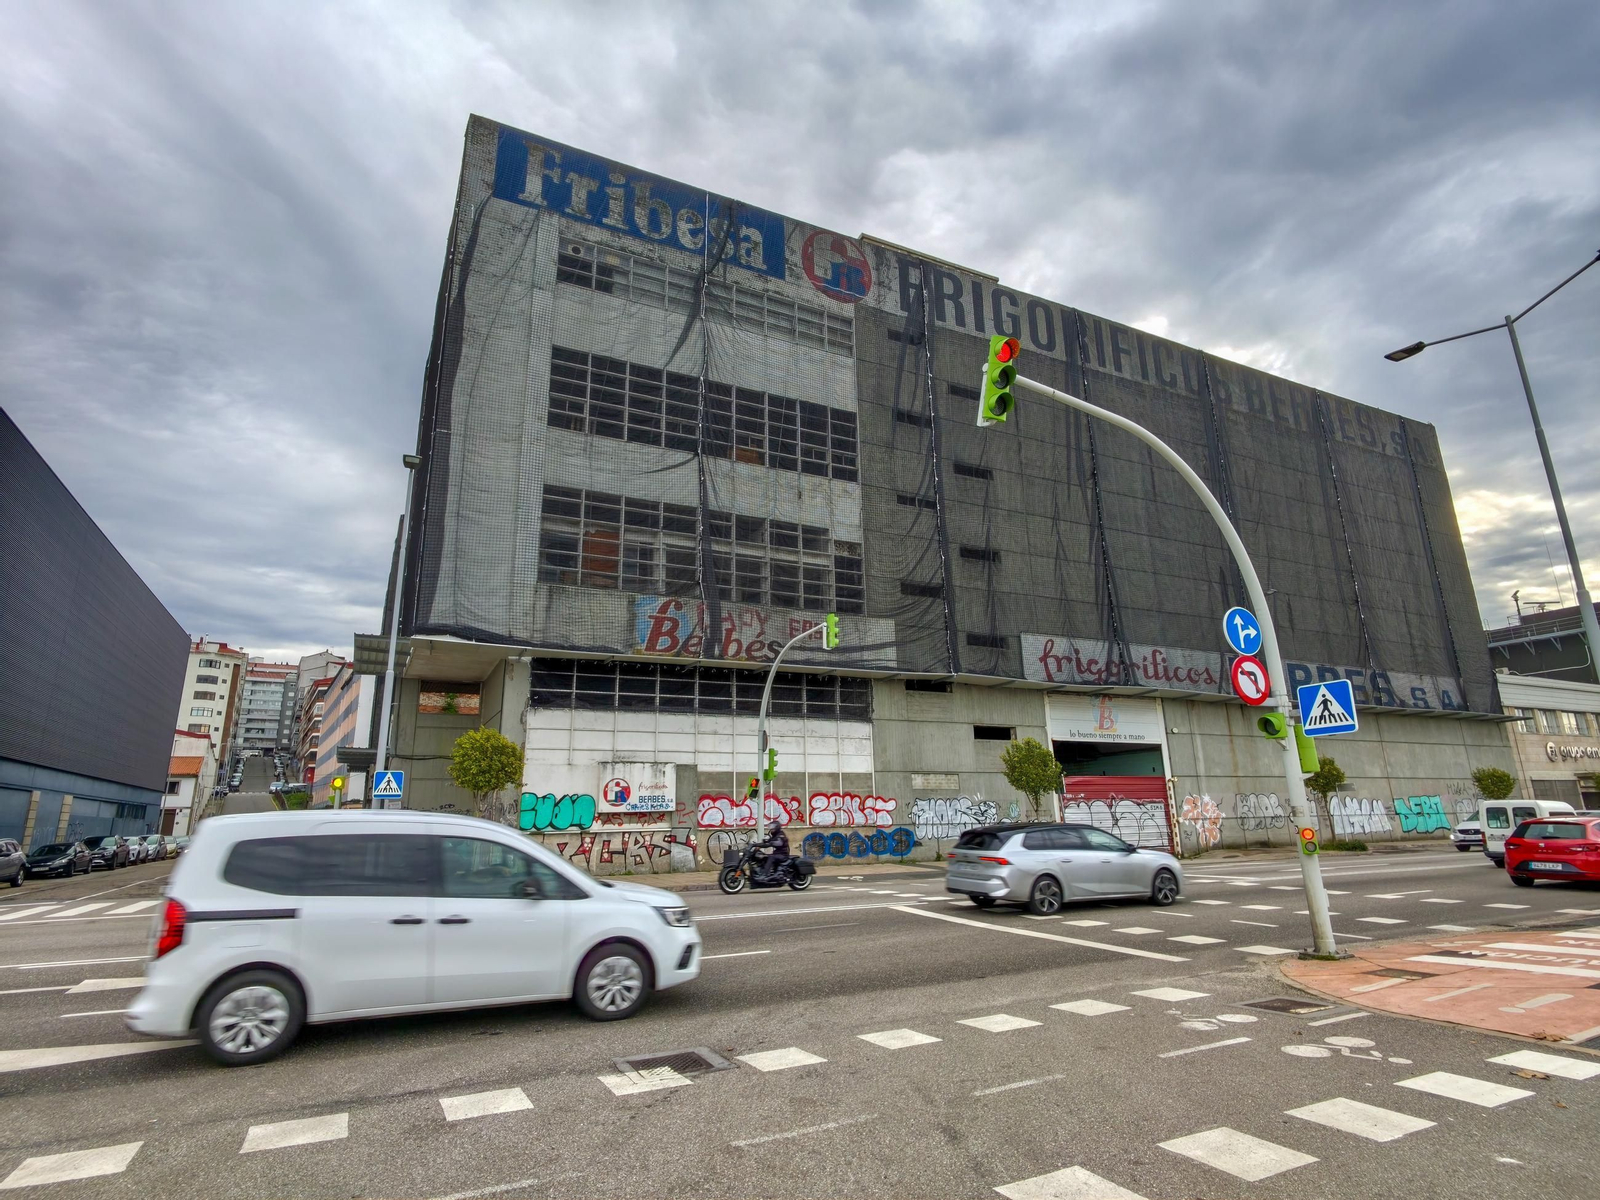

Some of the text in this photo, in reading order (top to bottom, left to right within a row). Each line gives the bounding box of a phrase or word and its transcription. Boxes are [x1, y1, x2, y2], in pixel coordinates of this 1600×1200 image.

[517, 139, 768, 271] Fribesa
[1069, 729, 1077, 738] lo
[1077, 729, 1098, 739] bueno
[1098, 733, 1122, 742] siempre
[1559, 745, 1586, 763] grupo
[638, 795, 666, 803] BERBES
